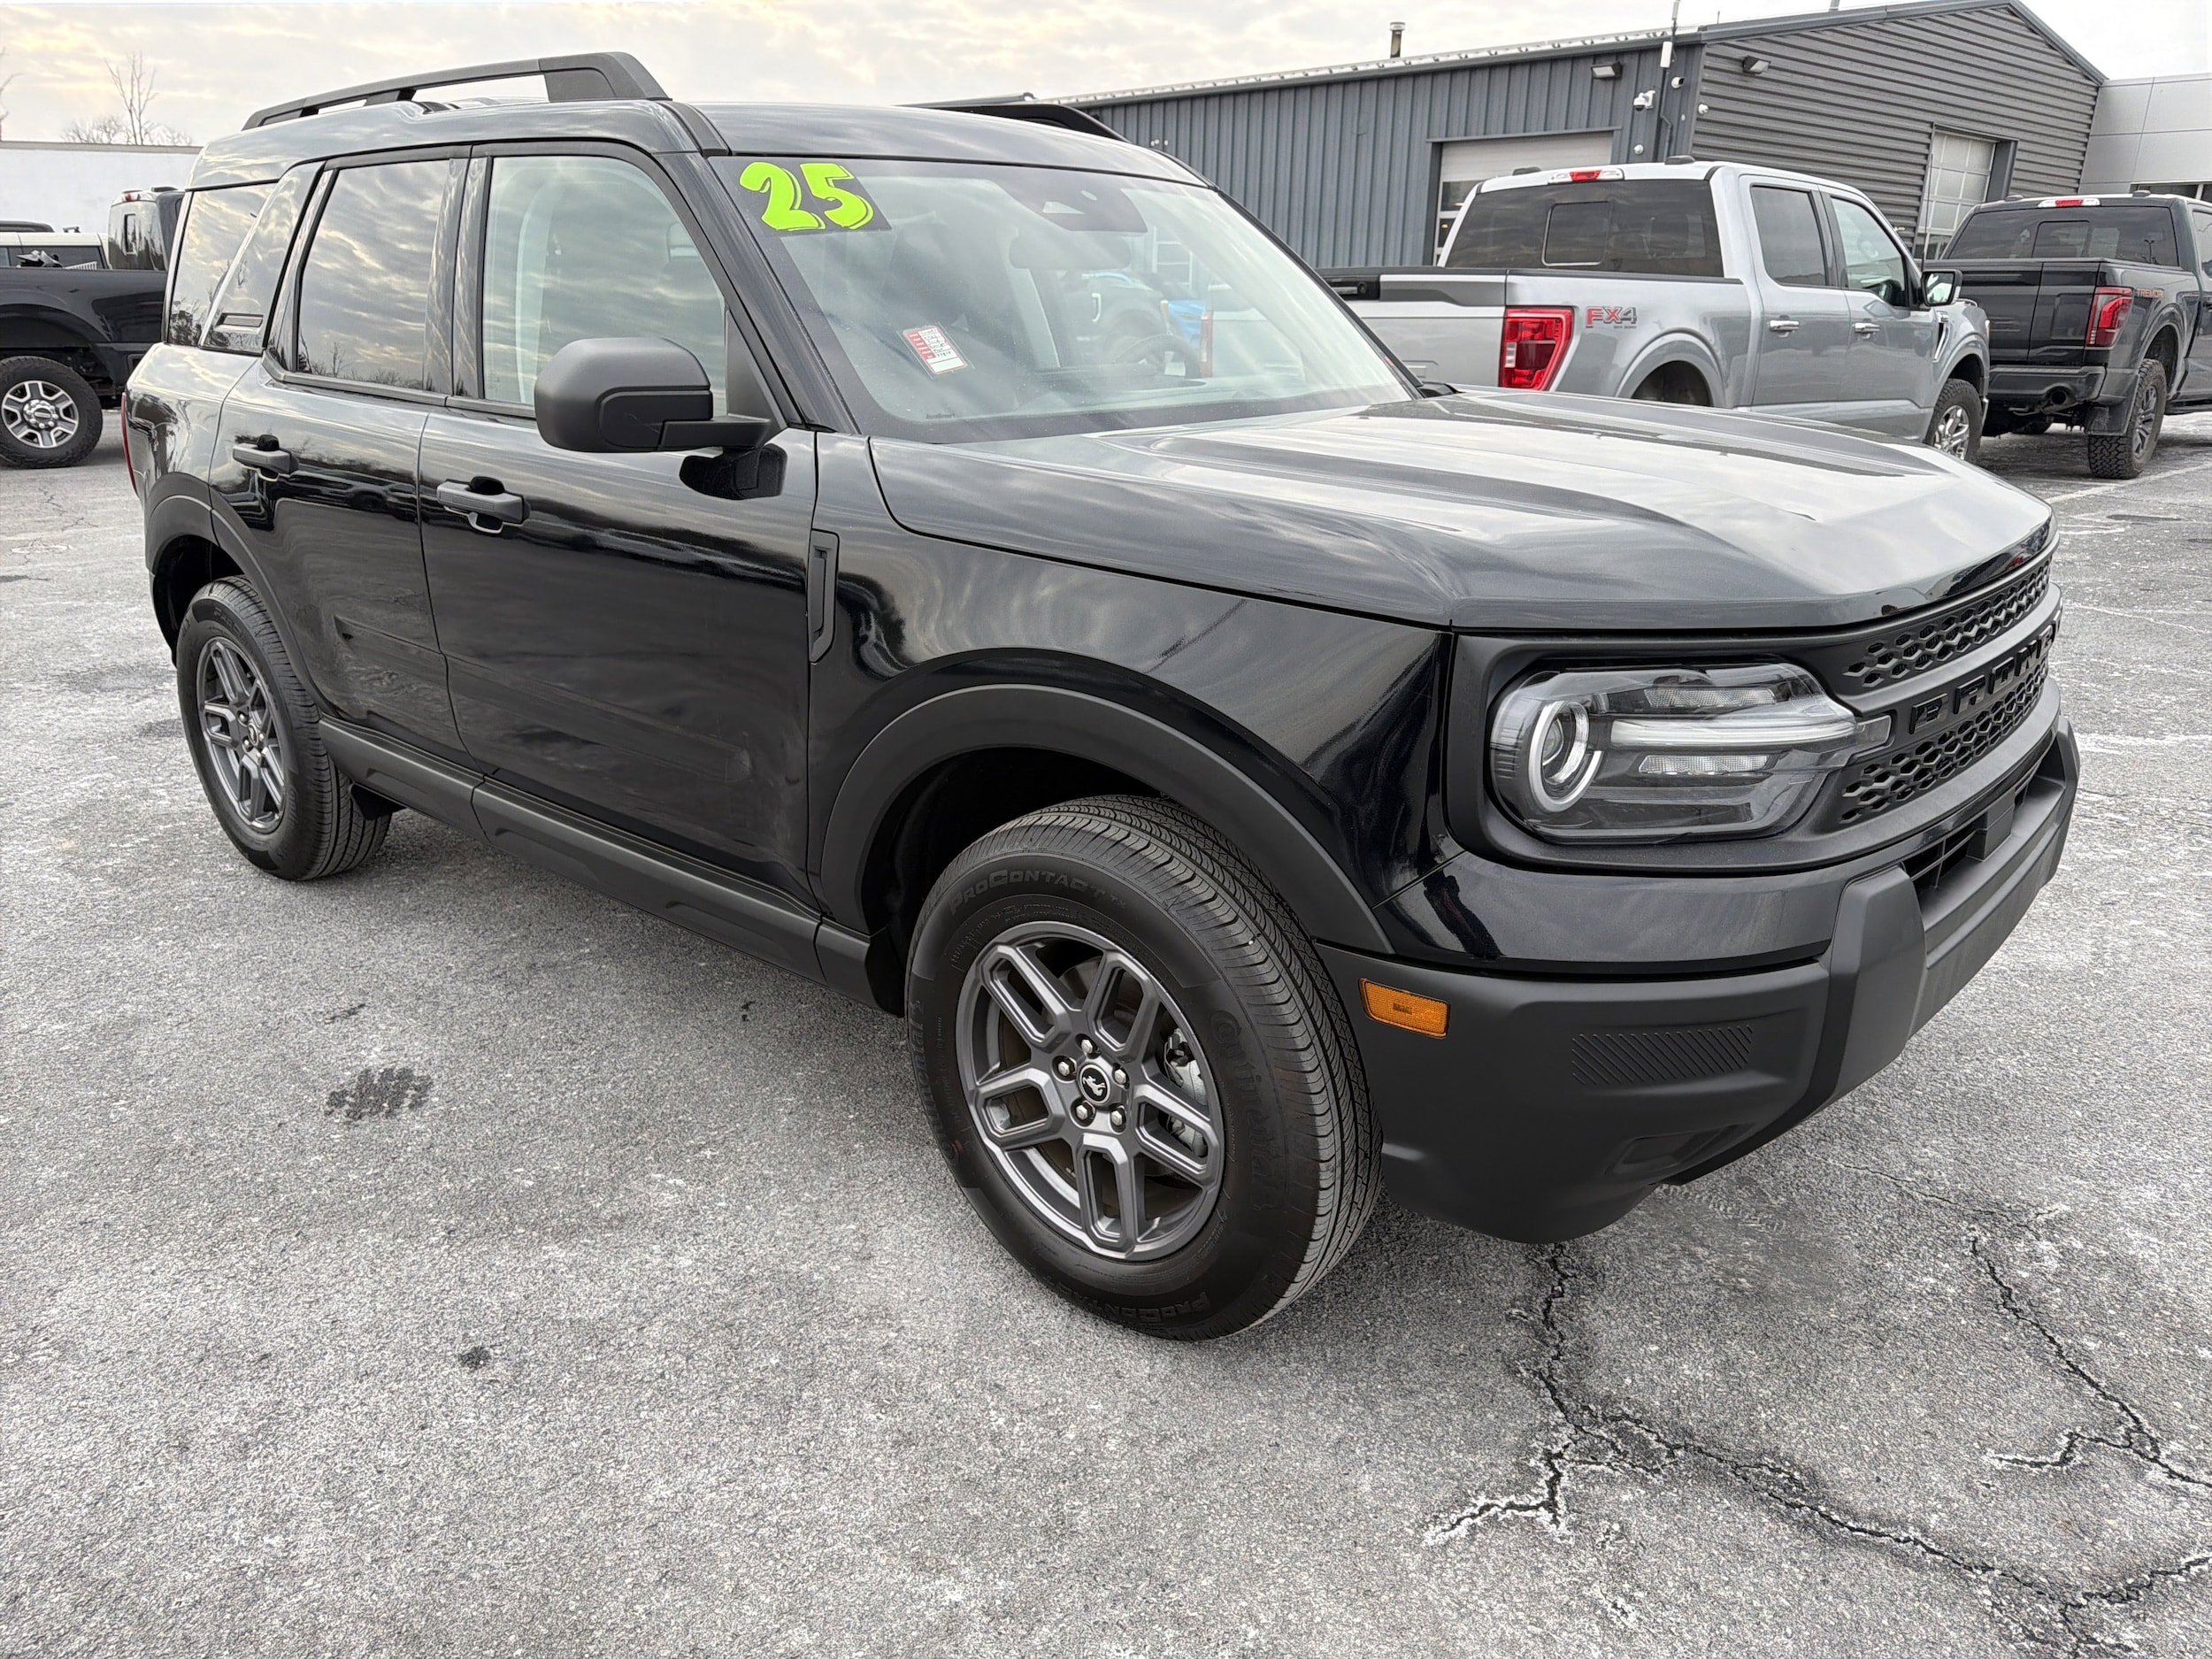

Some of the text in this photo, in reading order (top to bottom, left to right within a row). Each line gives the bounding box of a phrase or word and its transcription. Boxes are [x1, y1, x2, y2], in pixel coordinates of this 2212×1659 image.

[739, 161, 874, 231] 25
[2137, 288, 2164, 298] TREMOR
[1586, 306, 1638, 327] FX4
